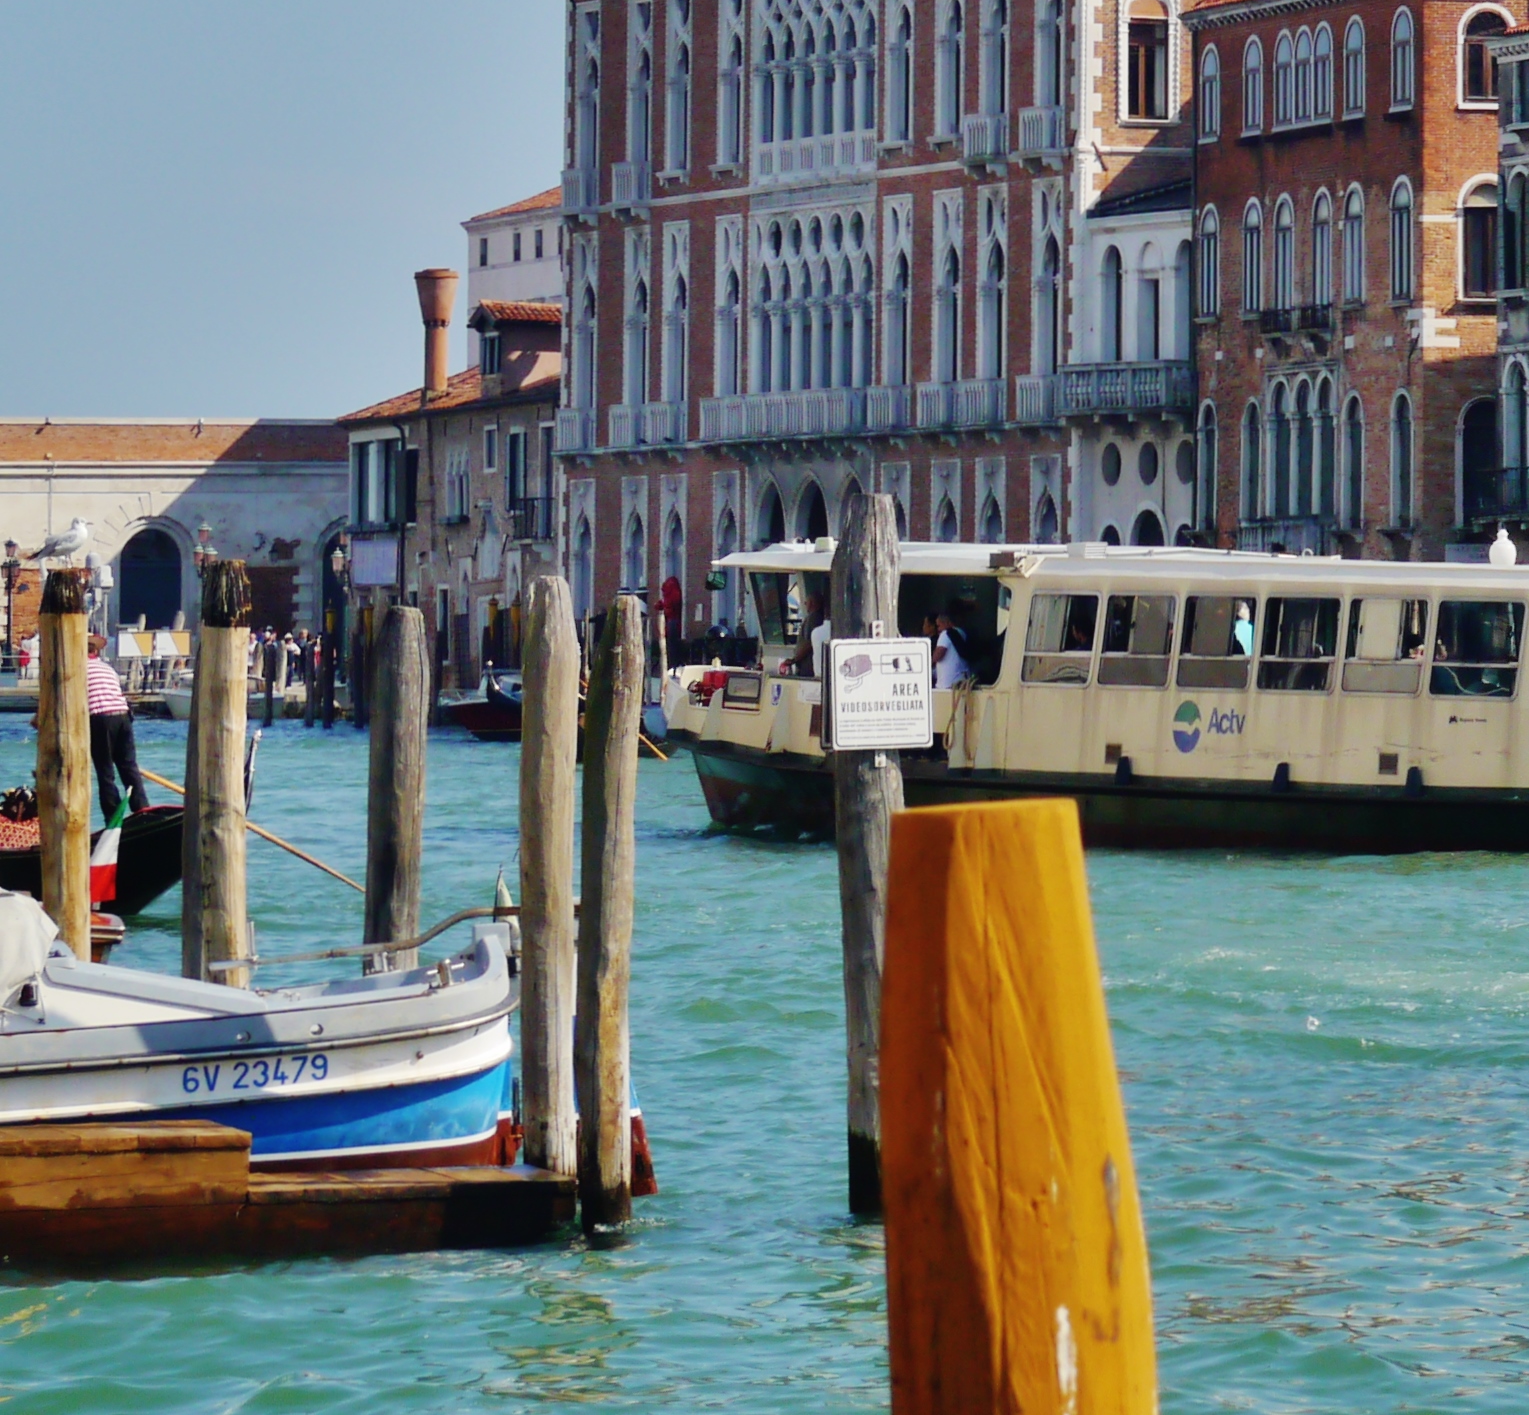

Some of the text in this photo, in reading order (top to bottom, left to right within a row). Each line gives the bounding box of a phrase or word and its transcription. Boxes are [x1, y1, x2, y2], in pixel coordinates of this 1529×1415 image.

[892, 683, 919, 697] AREA
[841, 700, 924, 713] VIDEOSORVEGLIATA
[1207, 707, 1246, 735] Actv
[182, 1053, 329, 1093] 6V 23479
